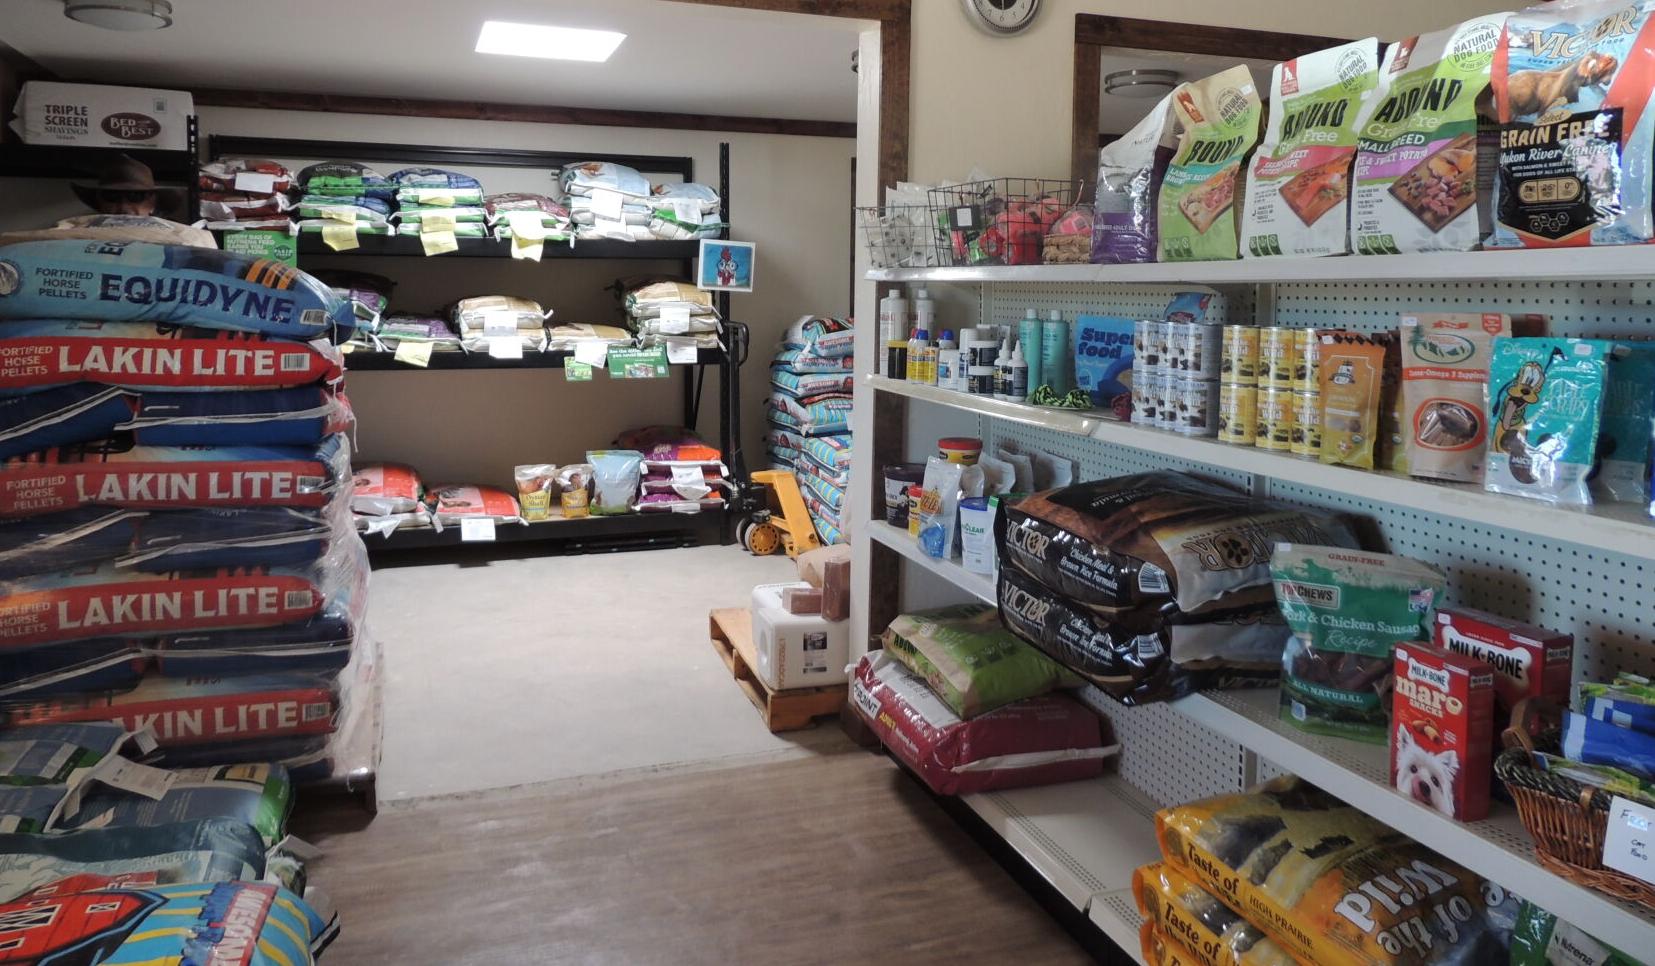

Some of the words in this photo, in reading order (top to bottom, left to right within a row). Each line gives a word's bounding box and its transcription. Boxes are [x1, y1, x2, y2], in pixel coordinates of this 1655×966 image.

[1453, 29, 1496, 54] NATURAL
[1530, 5, 1638, 59] VICOR
[1454, 49, 1473, 63] DOG
[45, 104, 88, 116] TRIPLE
[45, 115, 88, 127] SCREEN
[110, 117, 136, 129] BED
[121, 125, 154, 138] BEST
[1500, 125, 1551, 149] GRAIN
[1529, 147, 1563, 161] River
[1563, 141, 1611, 158] Canine
[35, 266, 94, 280] FORTIFIED
[39, 287, 87, 300] PELLETS
[43, 278, 81, 290] HORSE
[100, 272, 296, 324] EQUIDYNE
[0, 345, 53, 357] ORTIFIED
[58, 345, 181, 376] LAKIN
[193, 349, 276, 376] LITE
[1079, 341, 1123, 359] food
[1, 365, 48, 377] PELLETS
[4, 355, 40, 367] HORSE
[6, 475, 66, 491] FORTIFIED
[16, 487, 55, 499] HORSE
[76, 472, 197, 503] LAKIN
[208, 472, 292, 499] LITE
[1006, 518, 1050, 560] VICTOR
[1328, 552, 1385, 567] GRAIN-FREE
[57, 591, 182, 630] LAKIN
[193, 586, 279, 618] LITE
[1002, 580, 1050, 627] VICTOR
[1308, 612, 1318, 624] &
[1321, 614, 1375, 632] Chicken
[1324, 629, 1378, 651] Recipe
[1411, 664, 1446, 687] MILK-BONE
[1309, 685, 1365, 705] NATURAL
[1395, 675, 1464, 716] maro
[112, 708, 203, 739] KIN
[215, 701, 298, 734] LITE
[1187, 842, 1220, 881] Taste
[1223, 877, 1240, 895] of
[1333, 858, 1459, 935] Wild
[207, 888, 268, 966] AWESOM
[1164, 901, 1200, 945] Taste
[1203, 941, 1221, 960] of
[1249, 894, 1273, 919] HIGH
[1275, 911, 1314, 950] PRAIRIE
